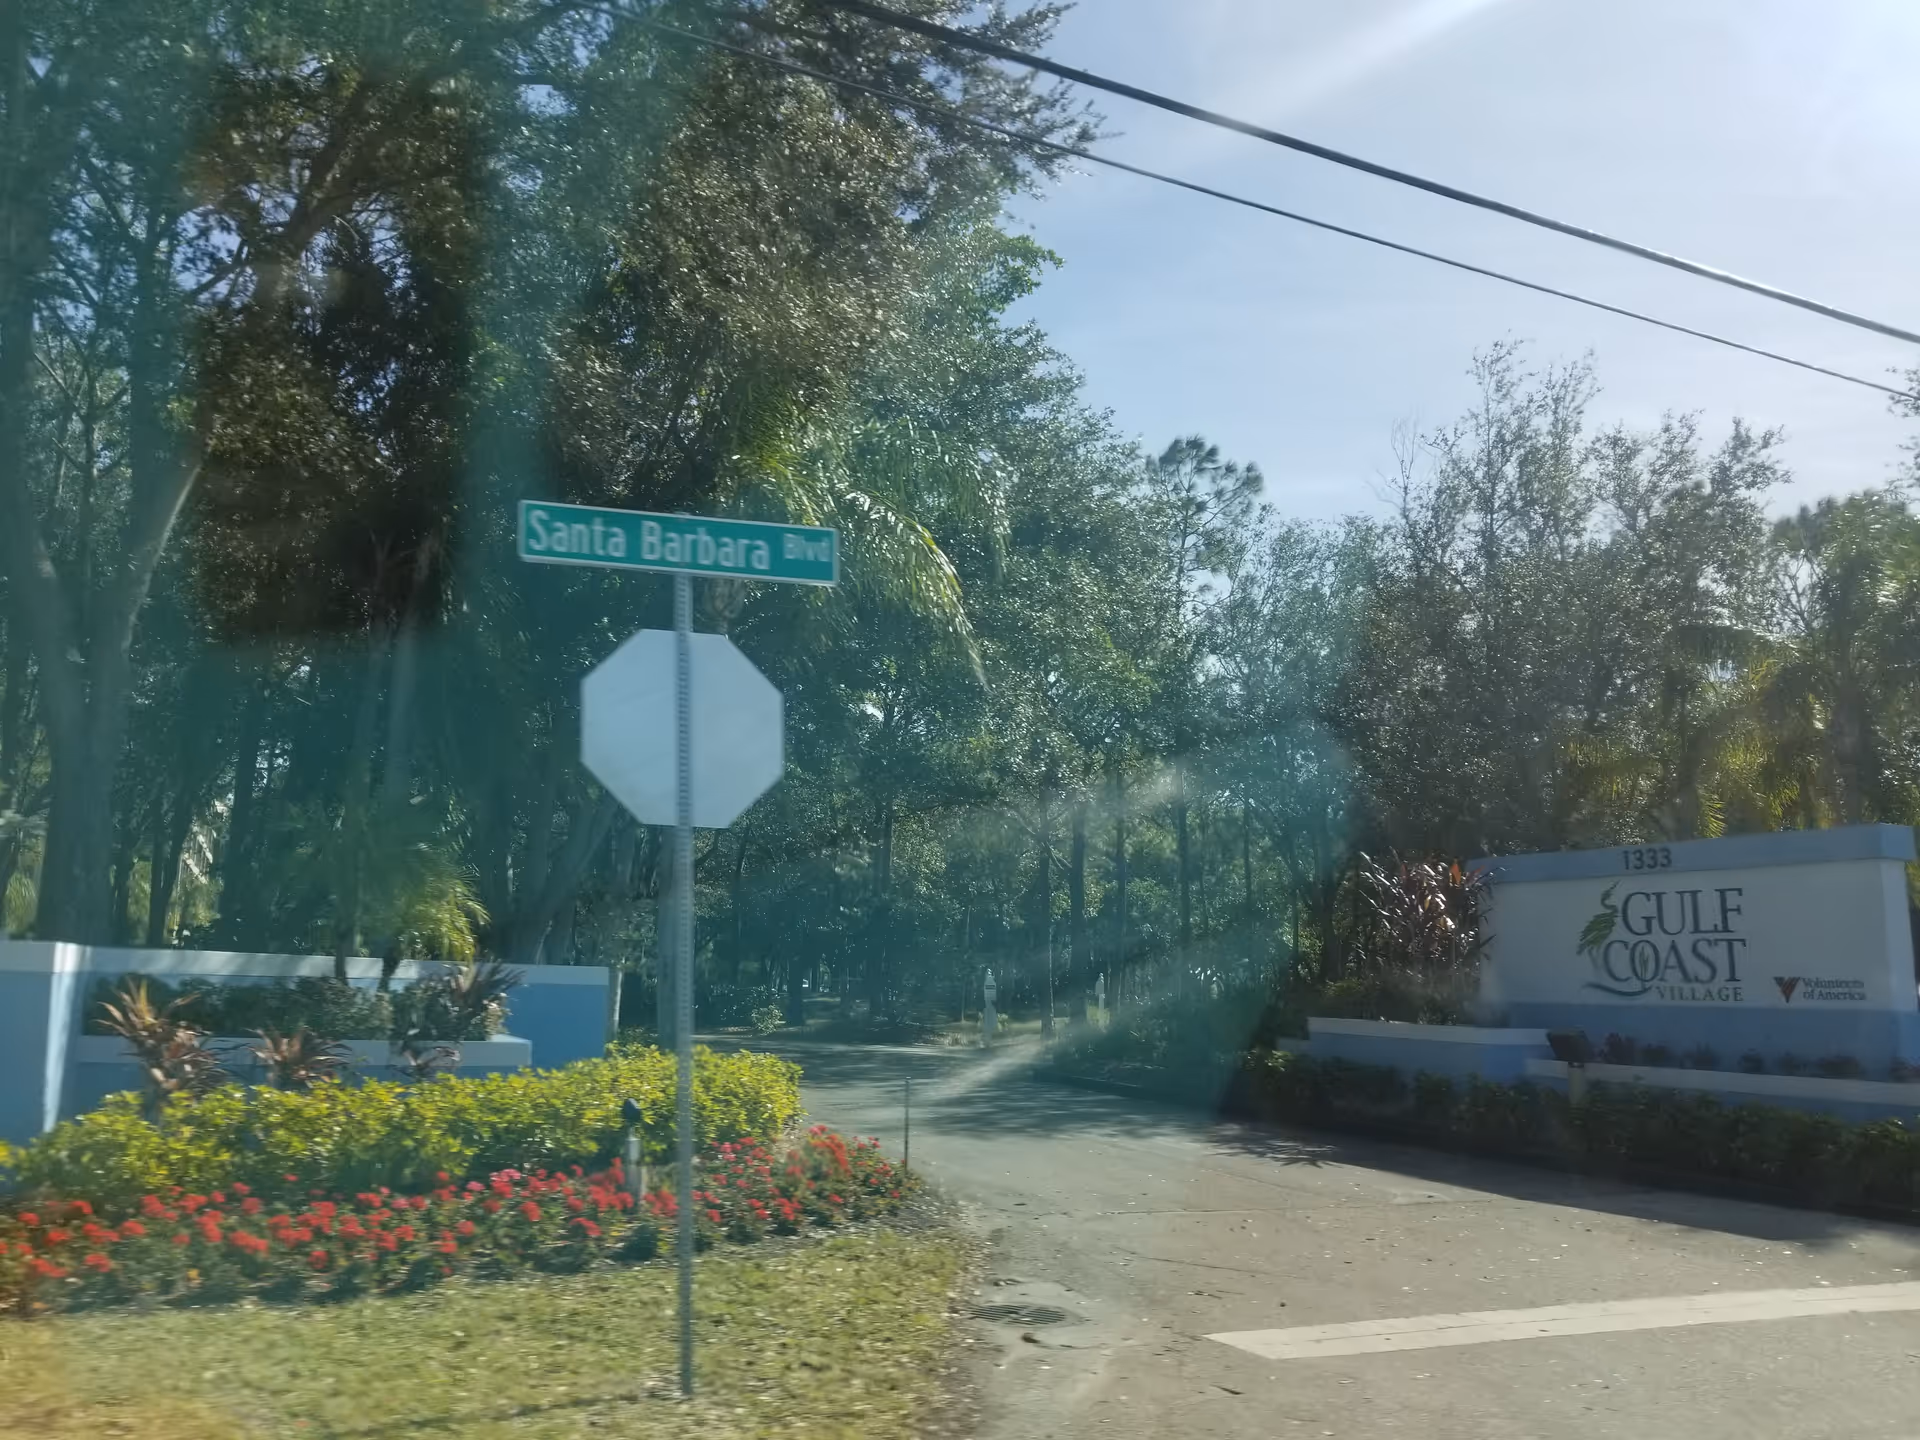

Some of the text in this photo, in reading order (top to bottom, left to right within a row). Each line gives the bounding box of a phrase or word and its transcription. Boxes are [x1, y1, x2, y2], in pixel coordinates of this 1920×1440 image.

[528, 509, 830, 570] Santa Barbara Blvd
[1622, 847, 1672, 871] 1333
[1621, 887, 1744, 937] GULF
[1603, 937, 1747, 984] COAST
[1655, 986, 1744, 1002] VILLAGE
[1801, 977, 1865, 989] Volunteers
[1817, 990, 1867, 1001] America
